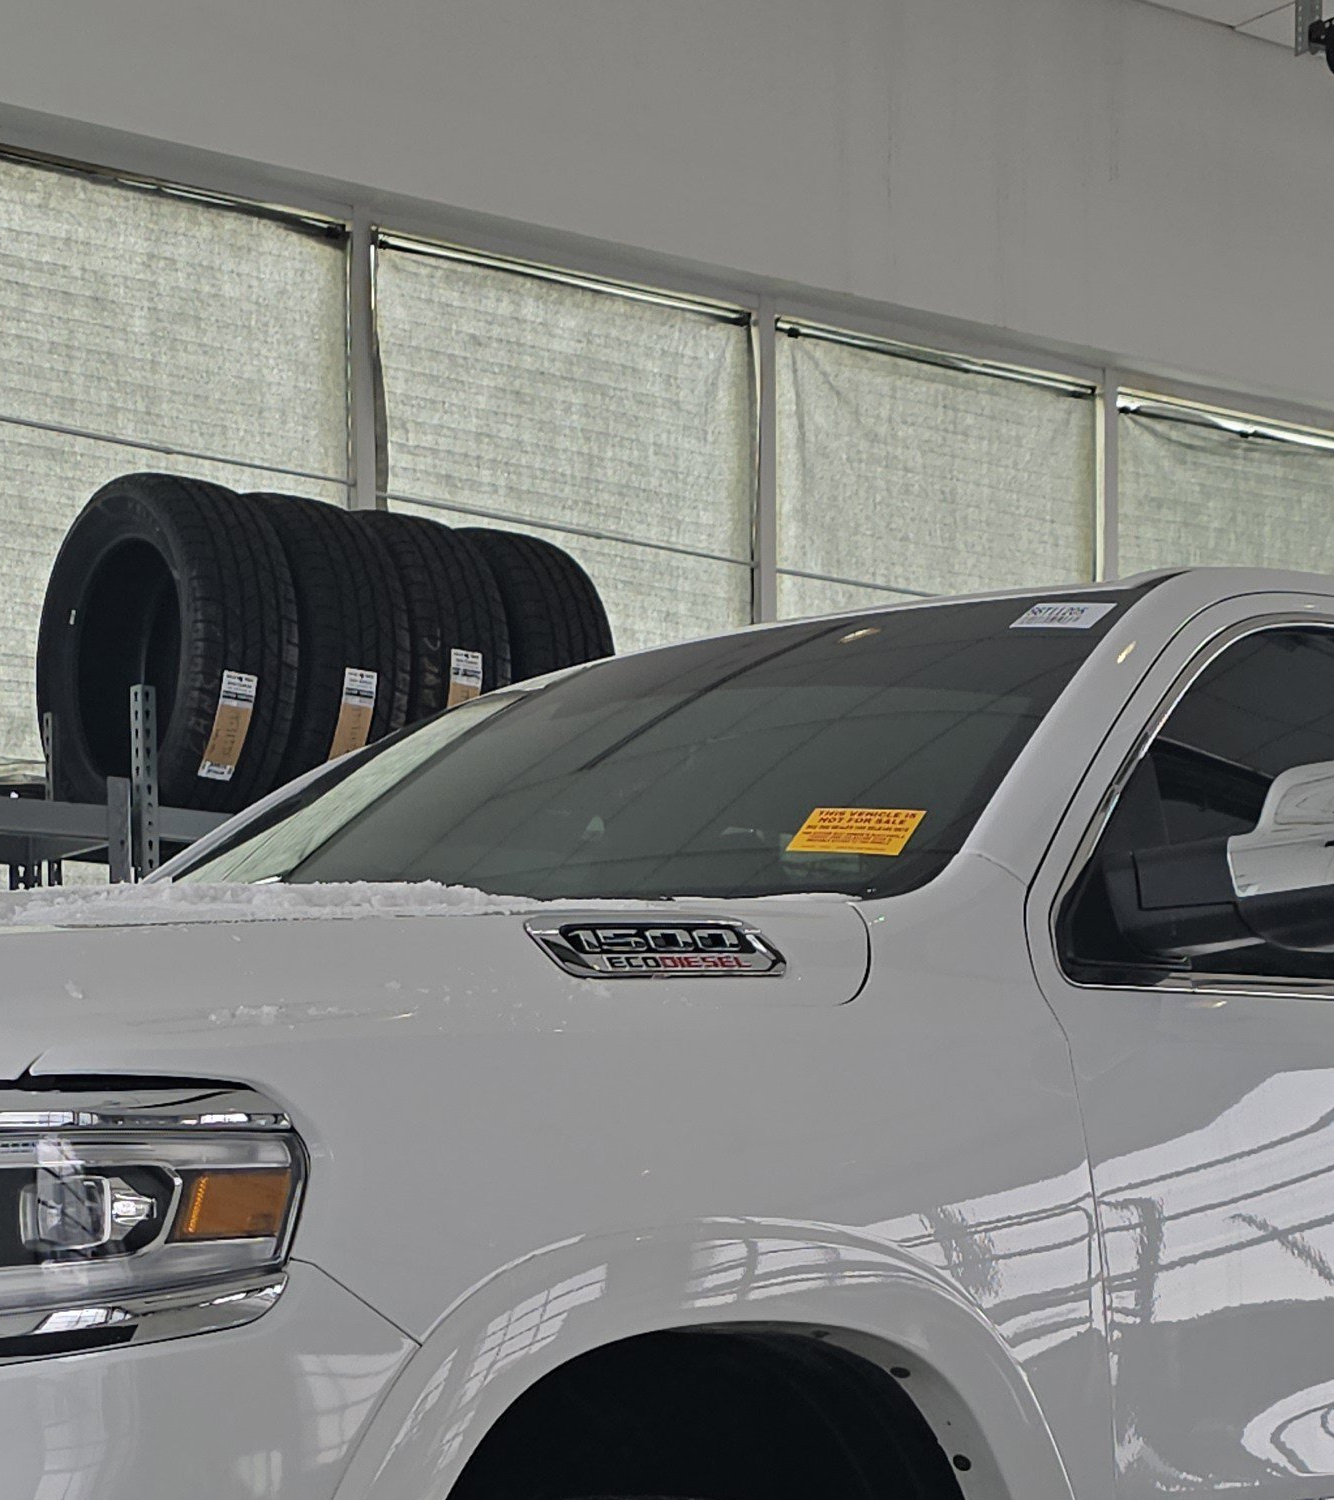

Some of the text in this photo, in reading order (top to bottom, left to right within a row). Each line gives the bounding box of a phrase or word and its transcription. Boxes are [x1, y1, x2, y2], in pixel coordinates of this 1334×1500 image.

[846, 817, 872, 825] FOR
[566, 928, 741, 952] 1500
[604, 955, 752, 971] ECODIESEL
